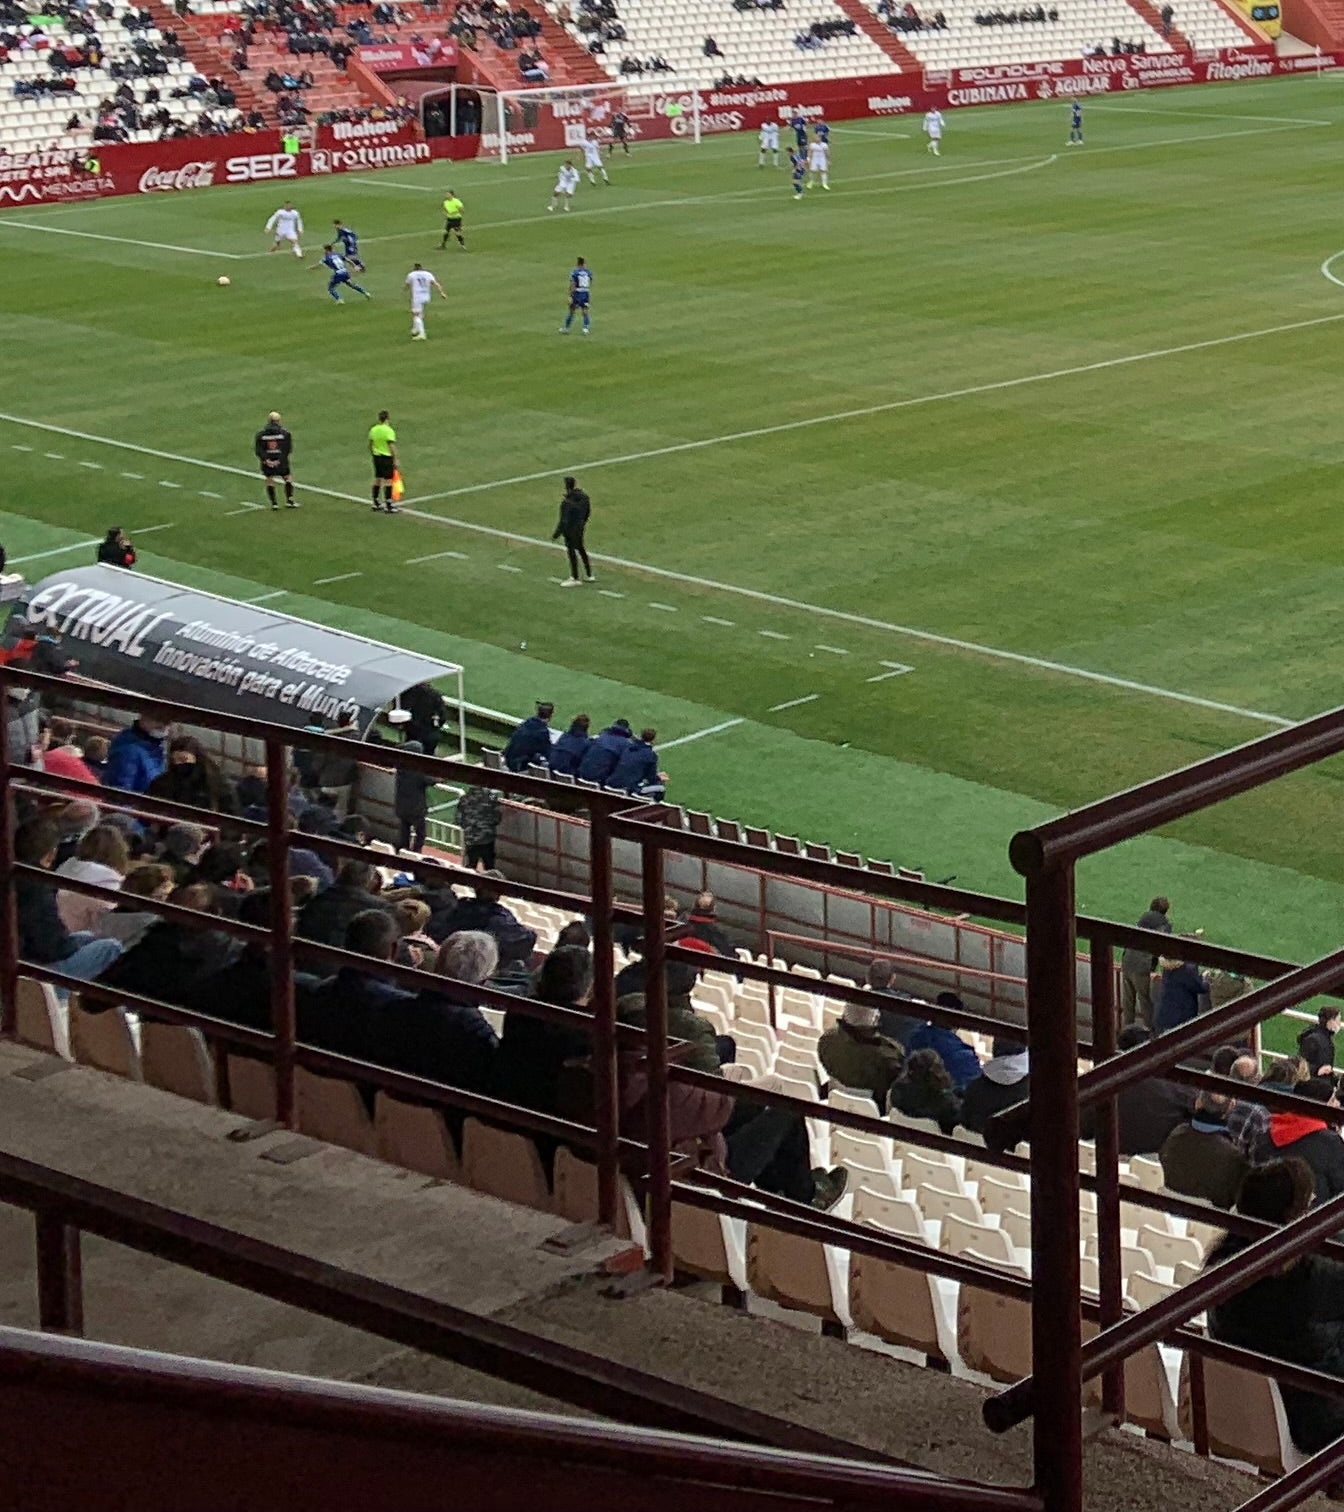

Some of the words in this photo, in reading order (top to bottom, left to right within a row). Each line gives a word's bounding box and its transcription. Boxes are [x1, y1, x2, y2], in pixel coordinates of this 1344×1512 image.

[331, 142, 431, 169] rotuman
[152, 640, 241, 684] Innovación
[238, 668, 278, 700] para
[280, 678, 299, 699] el
